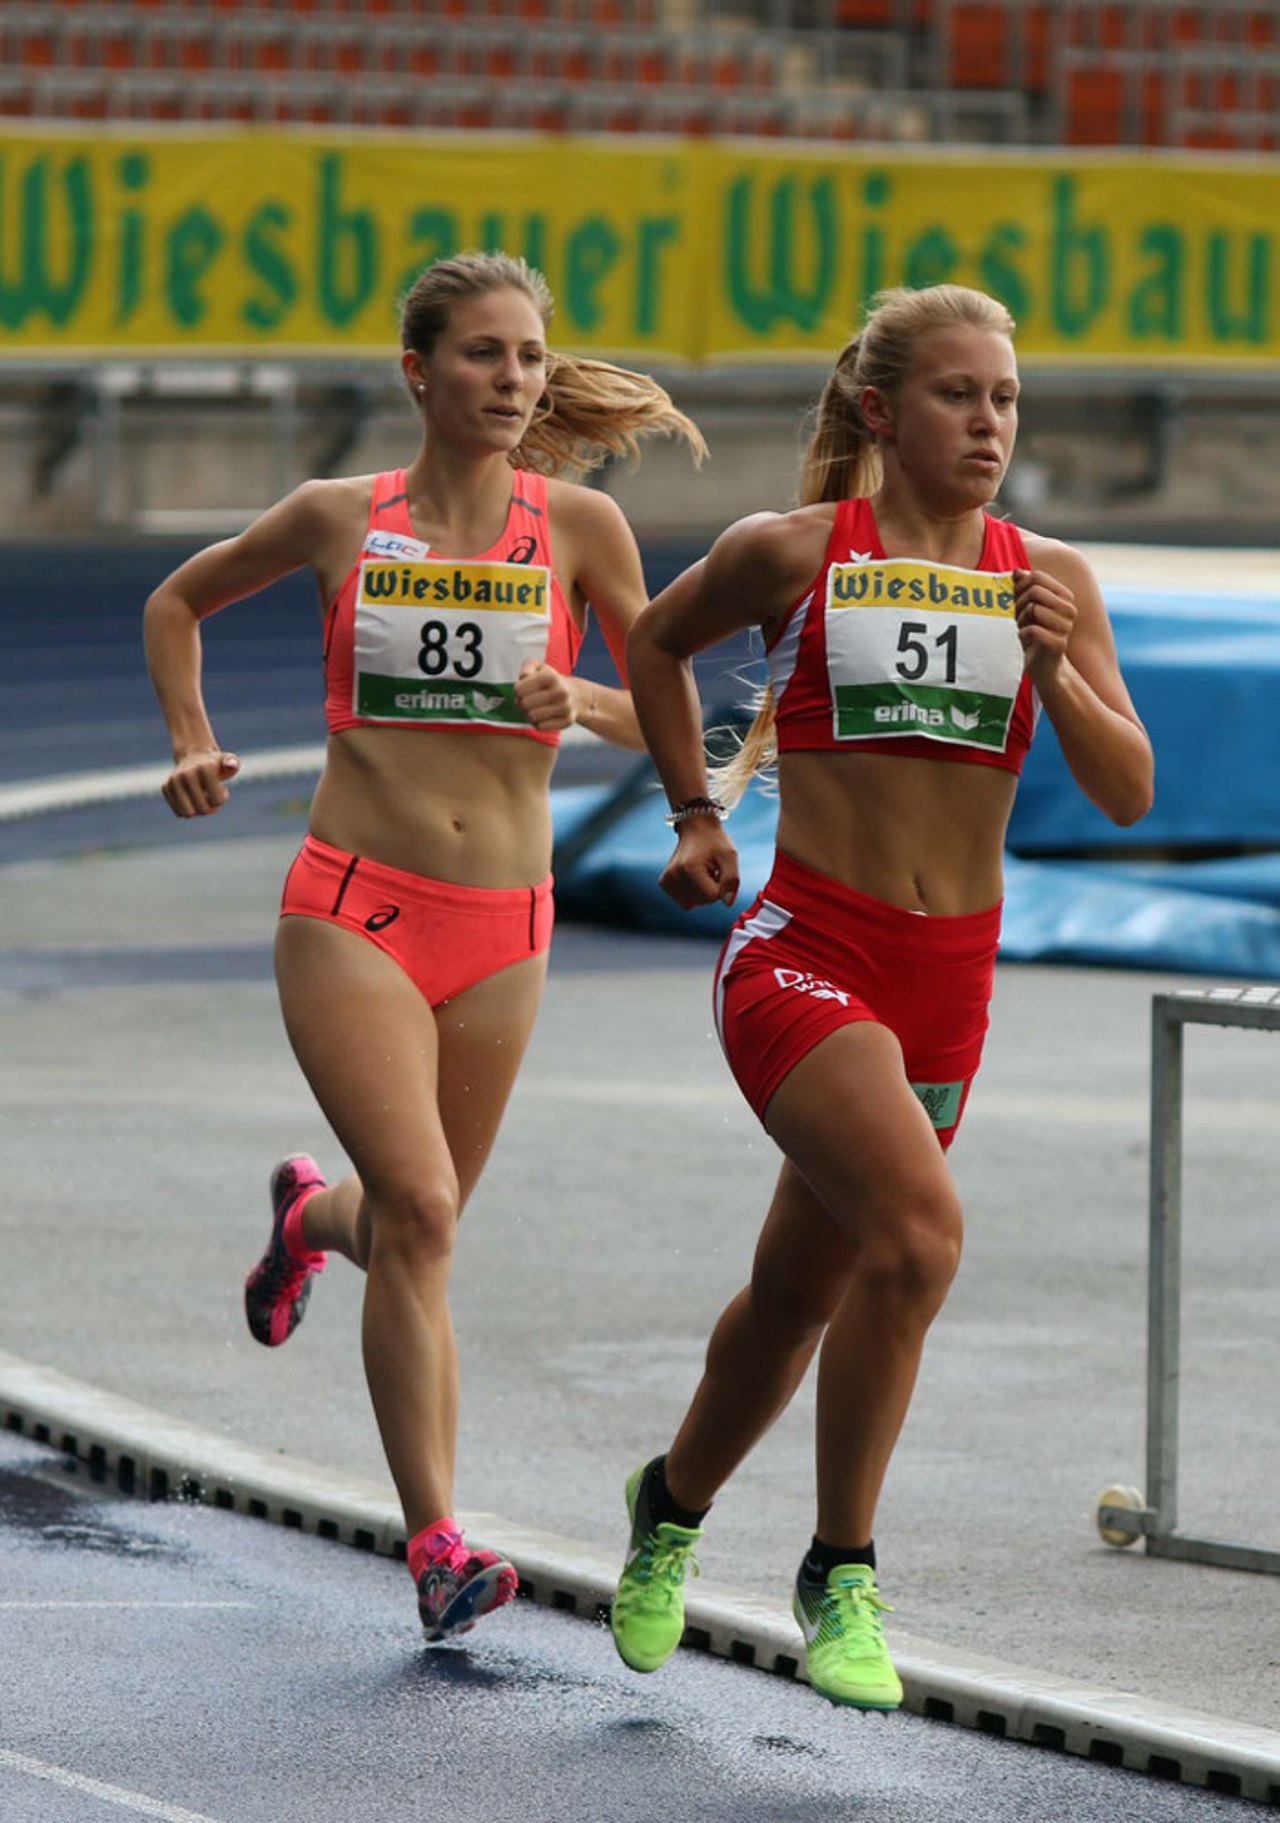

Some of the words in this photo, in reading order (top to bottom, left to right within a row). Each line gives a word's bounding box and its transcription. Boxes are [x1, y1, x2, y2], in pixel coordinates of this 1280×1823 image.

[364, 569, 545, 606] Wiesbauer
[417, 620, 483, 678] 83
[895, 622, 958, 683] 51
[395, 690, 465, 710] erima
[874, 701, 944, 726] erima
